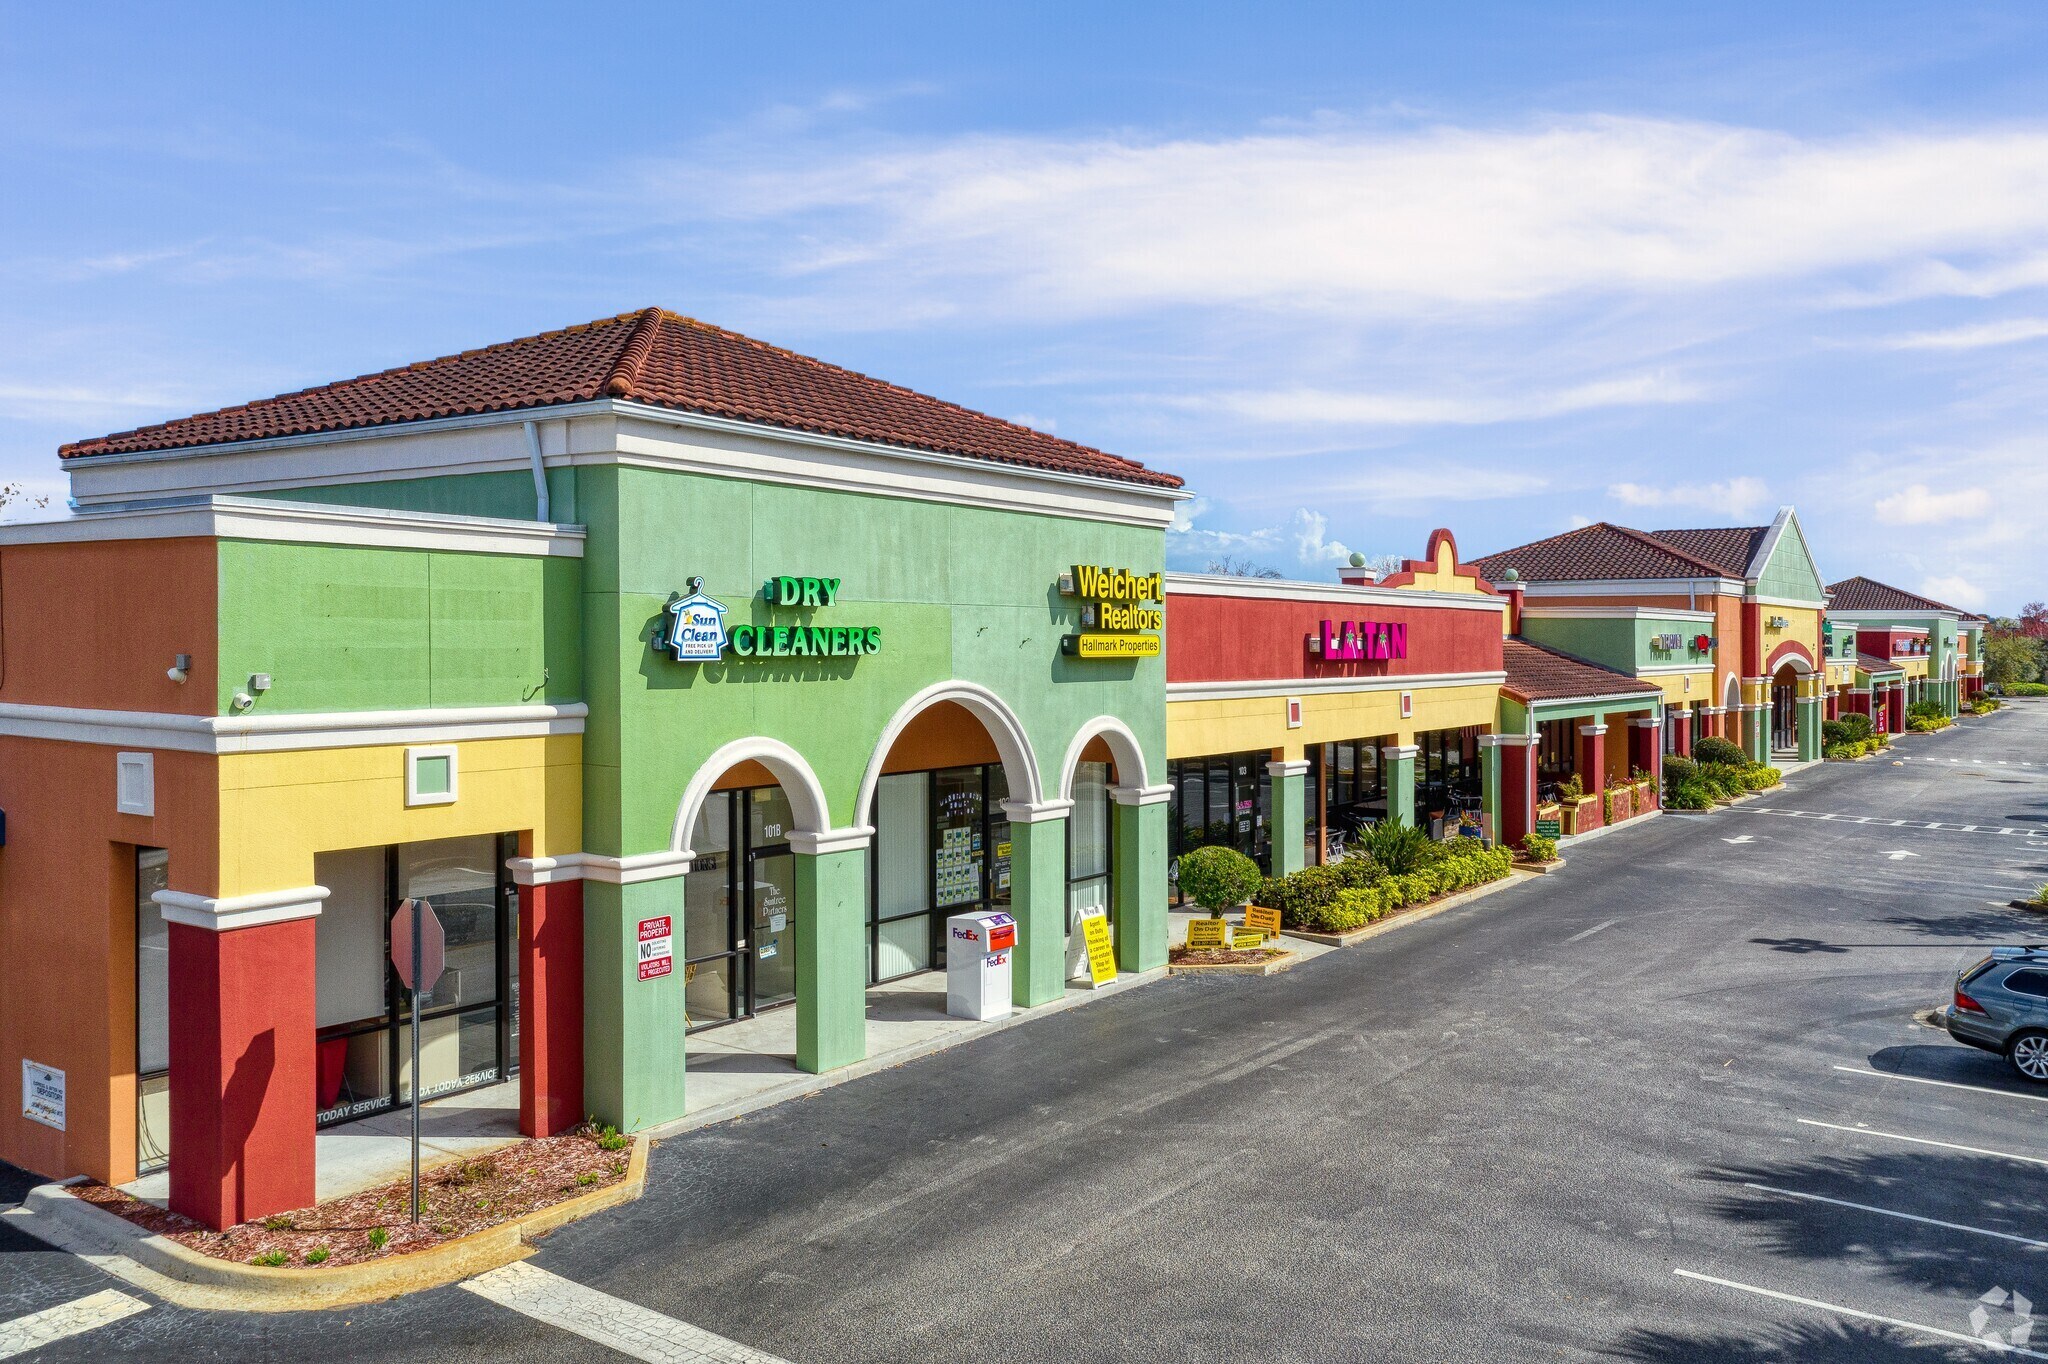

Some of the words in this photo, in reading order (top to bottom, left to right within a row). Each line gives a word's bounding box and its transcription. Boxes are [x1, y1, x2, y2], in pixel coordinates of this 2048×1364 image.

[779, 575, 841, 607] DRY
[692, 613, 717, 626] Sun
[1101, 602, 1162, 630] Realtors
[681, 628, 718, 642] Clean
[733, 624, 882, 657] CLEANERS
[1081, 639, 1118, 652] Hallmark
[1119, 639, 1158, 654] Properties
[1238, 766, 1247, 776] 103
[764, 823, 781, 838] 101B
[769, 886, 781, 896] The
[762, 905, 788, 917] Partners
[644, 919, 666, 930] PRIVATE
[1260, 914, 1276, 923] Duty
[640, 926, 669, 939] PROPERTY
[952, 927, 979, 942] FedEx
[640, 942, 652, 960] NO
[640, 961, 660, 971] VIOLATORS
[661, 958, 671, 967] WILL
[986, 954, 1007, 968] FedEx
[640, 970, 647, 978] BE
[647, 965, 671, 977] PROSECUTED
[316, 1106, 351, 1124] TODAY
[352, 1095, 392, 1115] SERVICE
